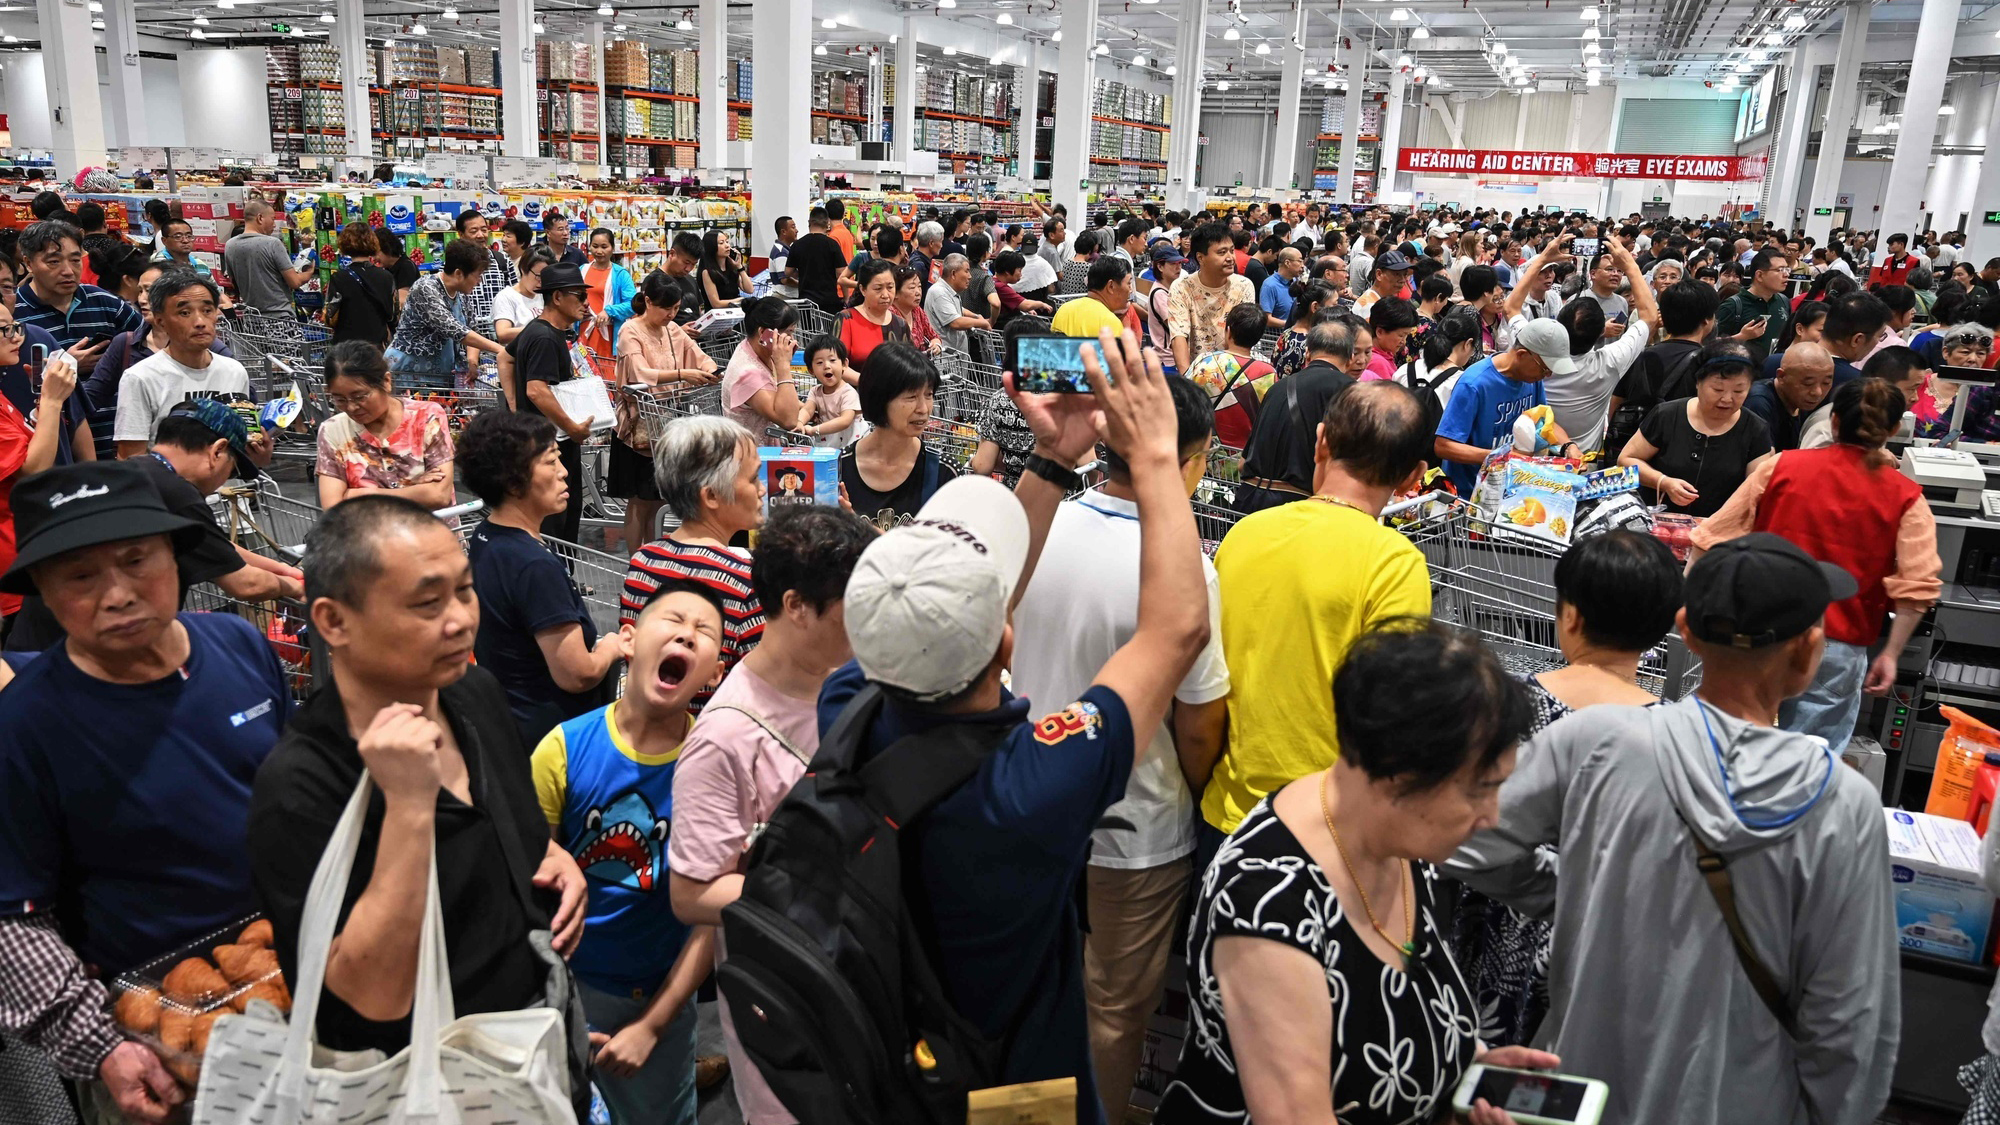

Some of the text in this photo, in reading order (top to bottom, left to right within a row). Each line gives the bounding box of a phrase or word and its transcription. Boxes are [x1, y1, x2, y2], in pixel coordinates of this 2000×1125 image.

[287, 89, 301, 98] 209
[404, 89, 418, 99] 207
[537, 90, 547, 99] 05
[1409, 152, 1574, 172] HEARING AID CENTER
[1594, 158, 1641, 175] 验光室
[1645, 159, 1674, 175] EYE
[1675, 159, 1728, 177] EXAMS
[1512, 470, 1573, 494] Mango
[1033, 713, 1086, 746] 8
[1900, 936, 1923, 949] 300
